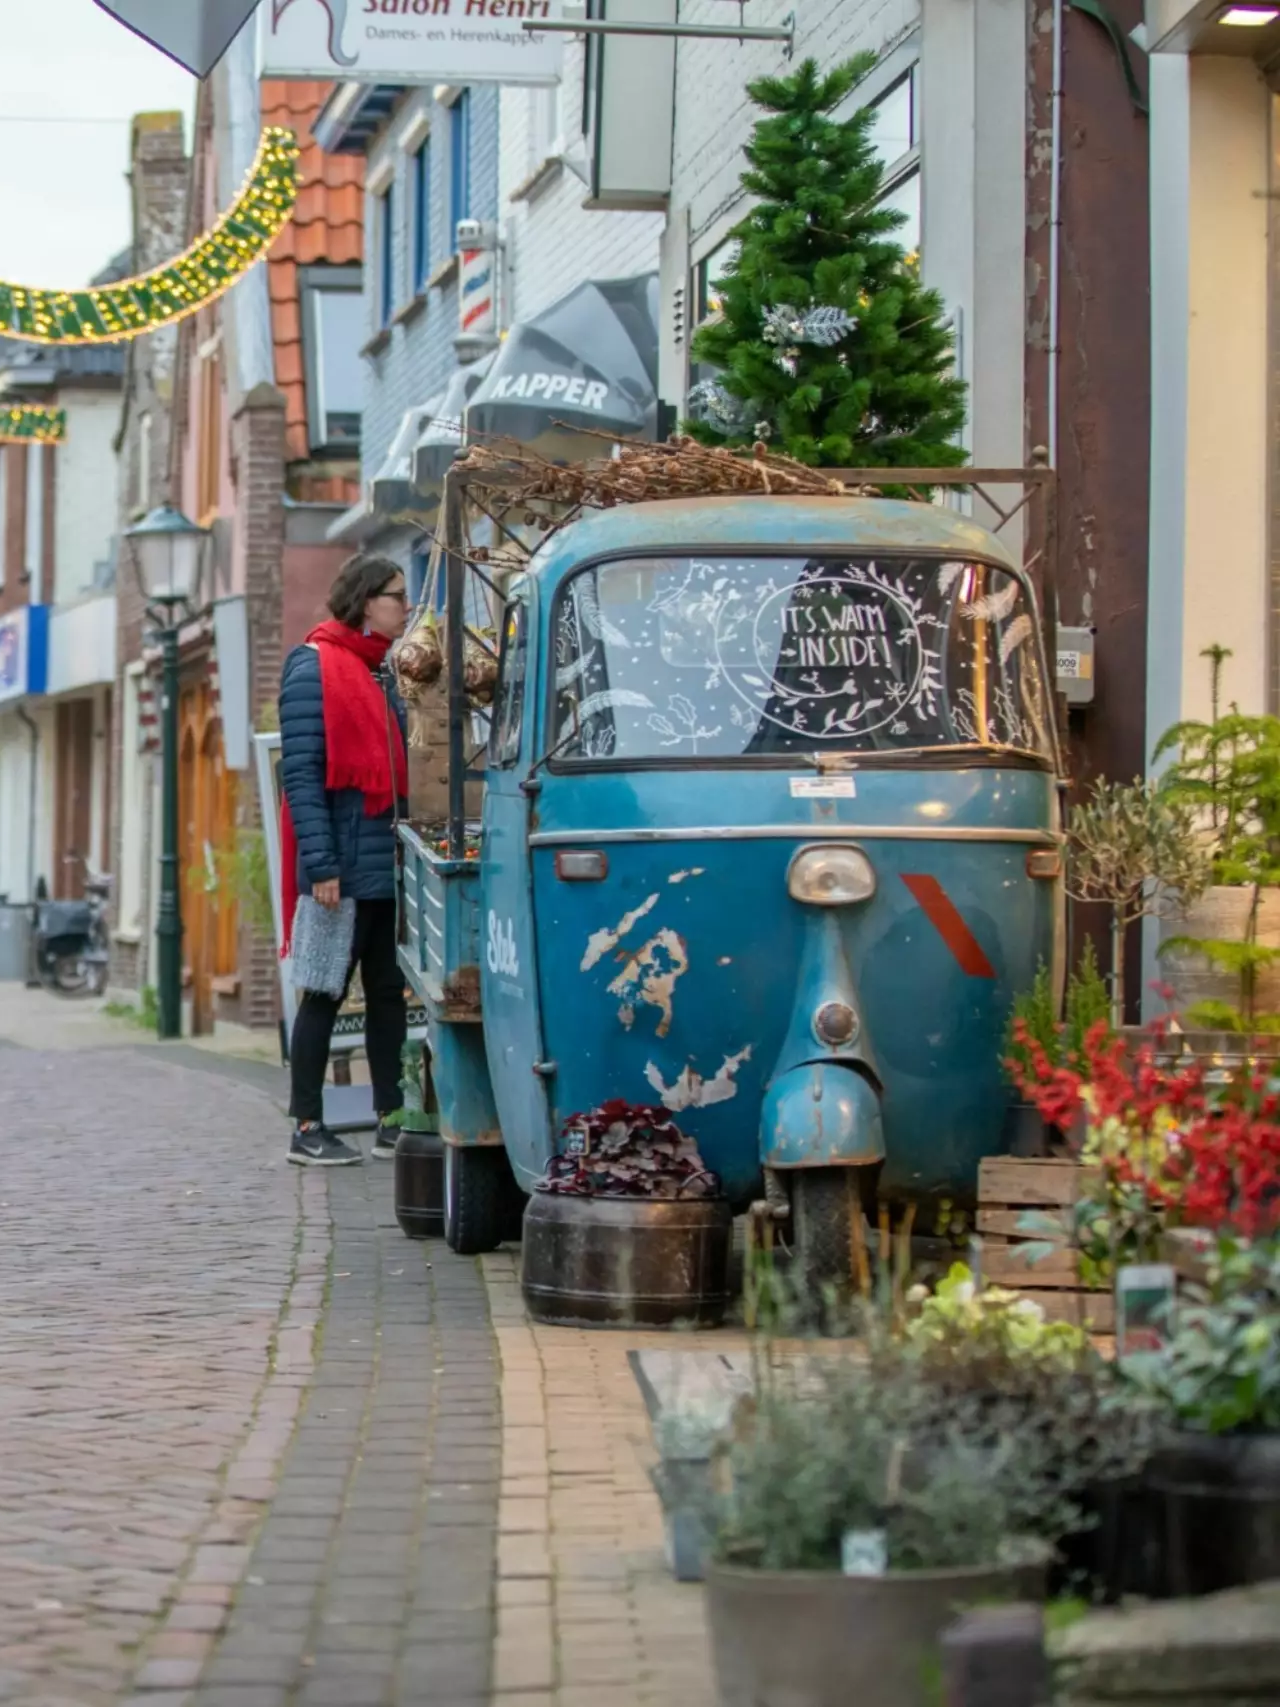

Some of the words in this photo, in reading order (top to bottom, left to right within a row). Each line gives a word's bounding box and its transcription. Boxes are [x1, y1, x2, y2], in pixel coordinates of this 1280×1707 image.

[365, 25, 422, 41] Dames-
[426, 30, 445, 41] en
[490, 372, 609, 409] KAPPER
[799, 635, 892, 669] INSIDE!
